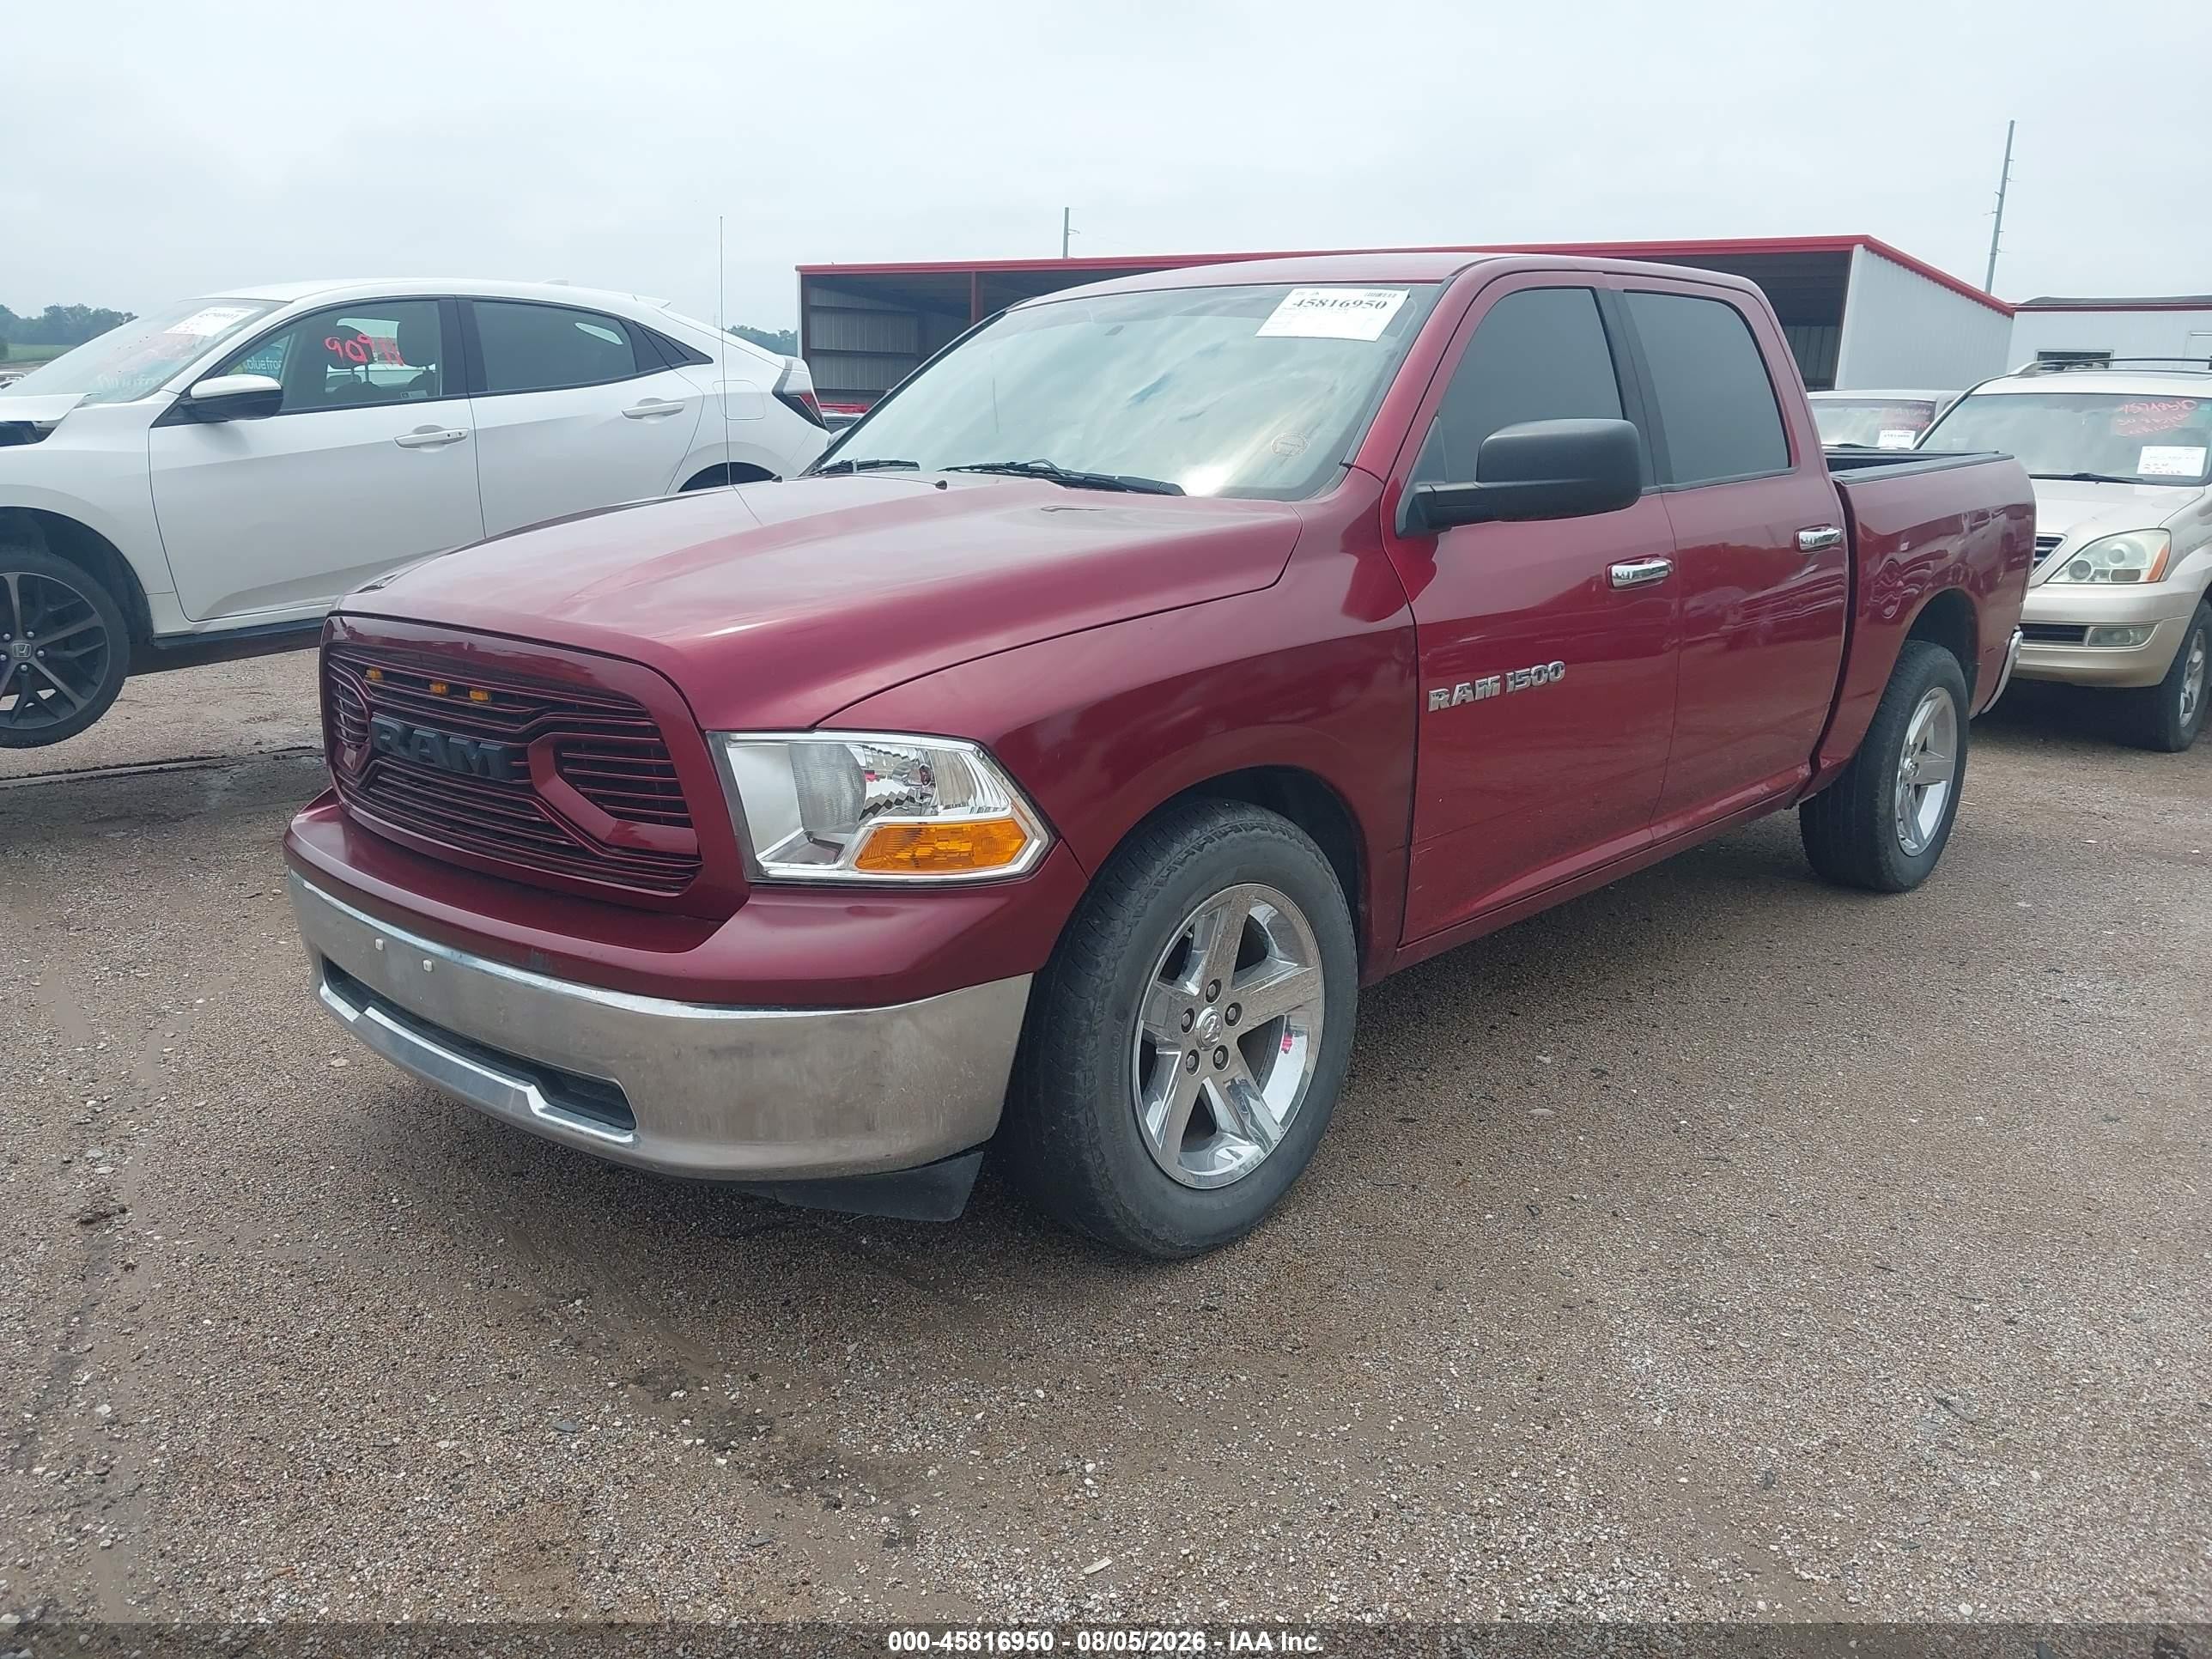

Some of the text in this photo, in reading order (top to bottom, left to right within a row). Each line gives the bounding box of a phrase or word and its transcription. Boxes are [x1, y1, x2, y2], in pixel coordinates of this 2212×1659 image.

[1293, 298, 1388, 310] 45816950
[1428, 660, 1565, 713] RAM 1500
[371, 717, 513, 781] RAM
